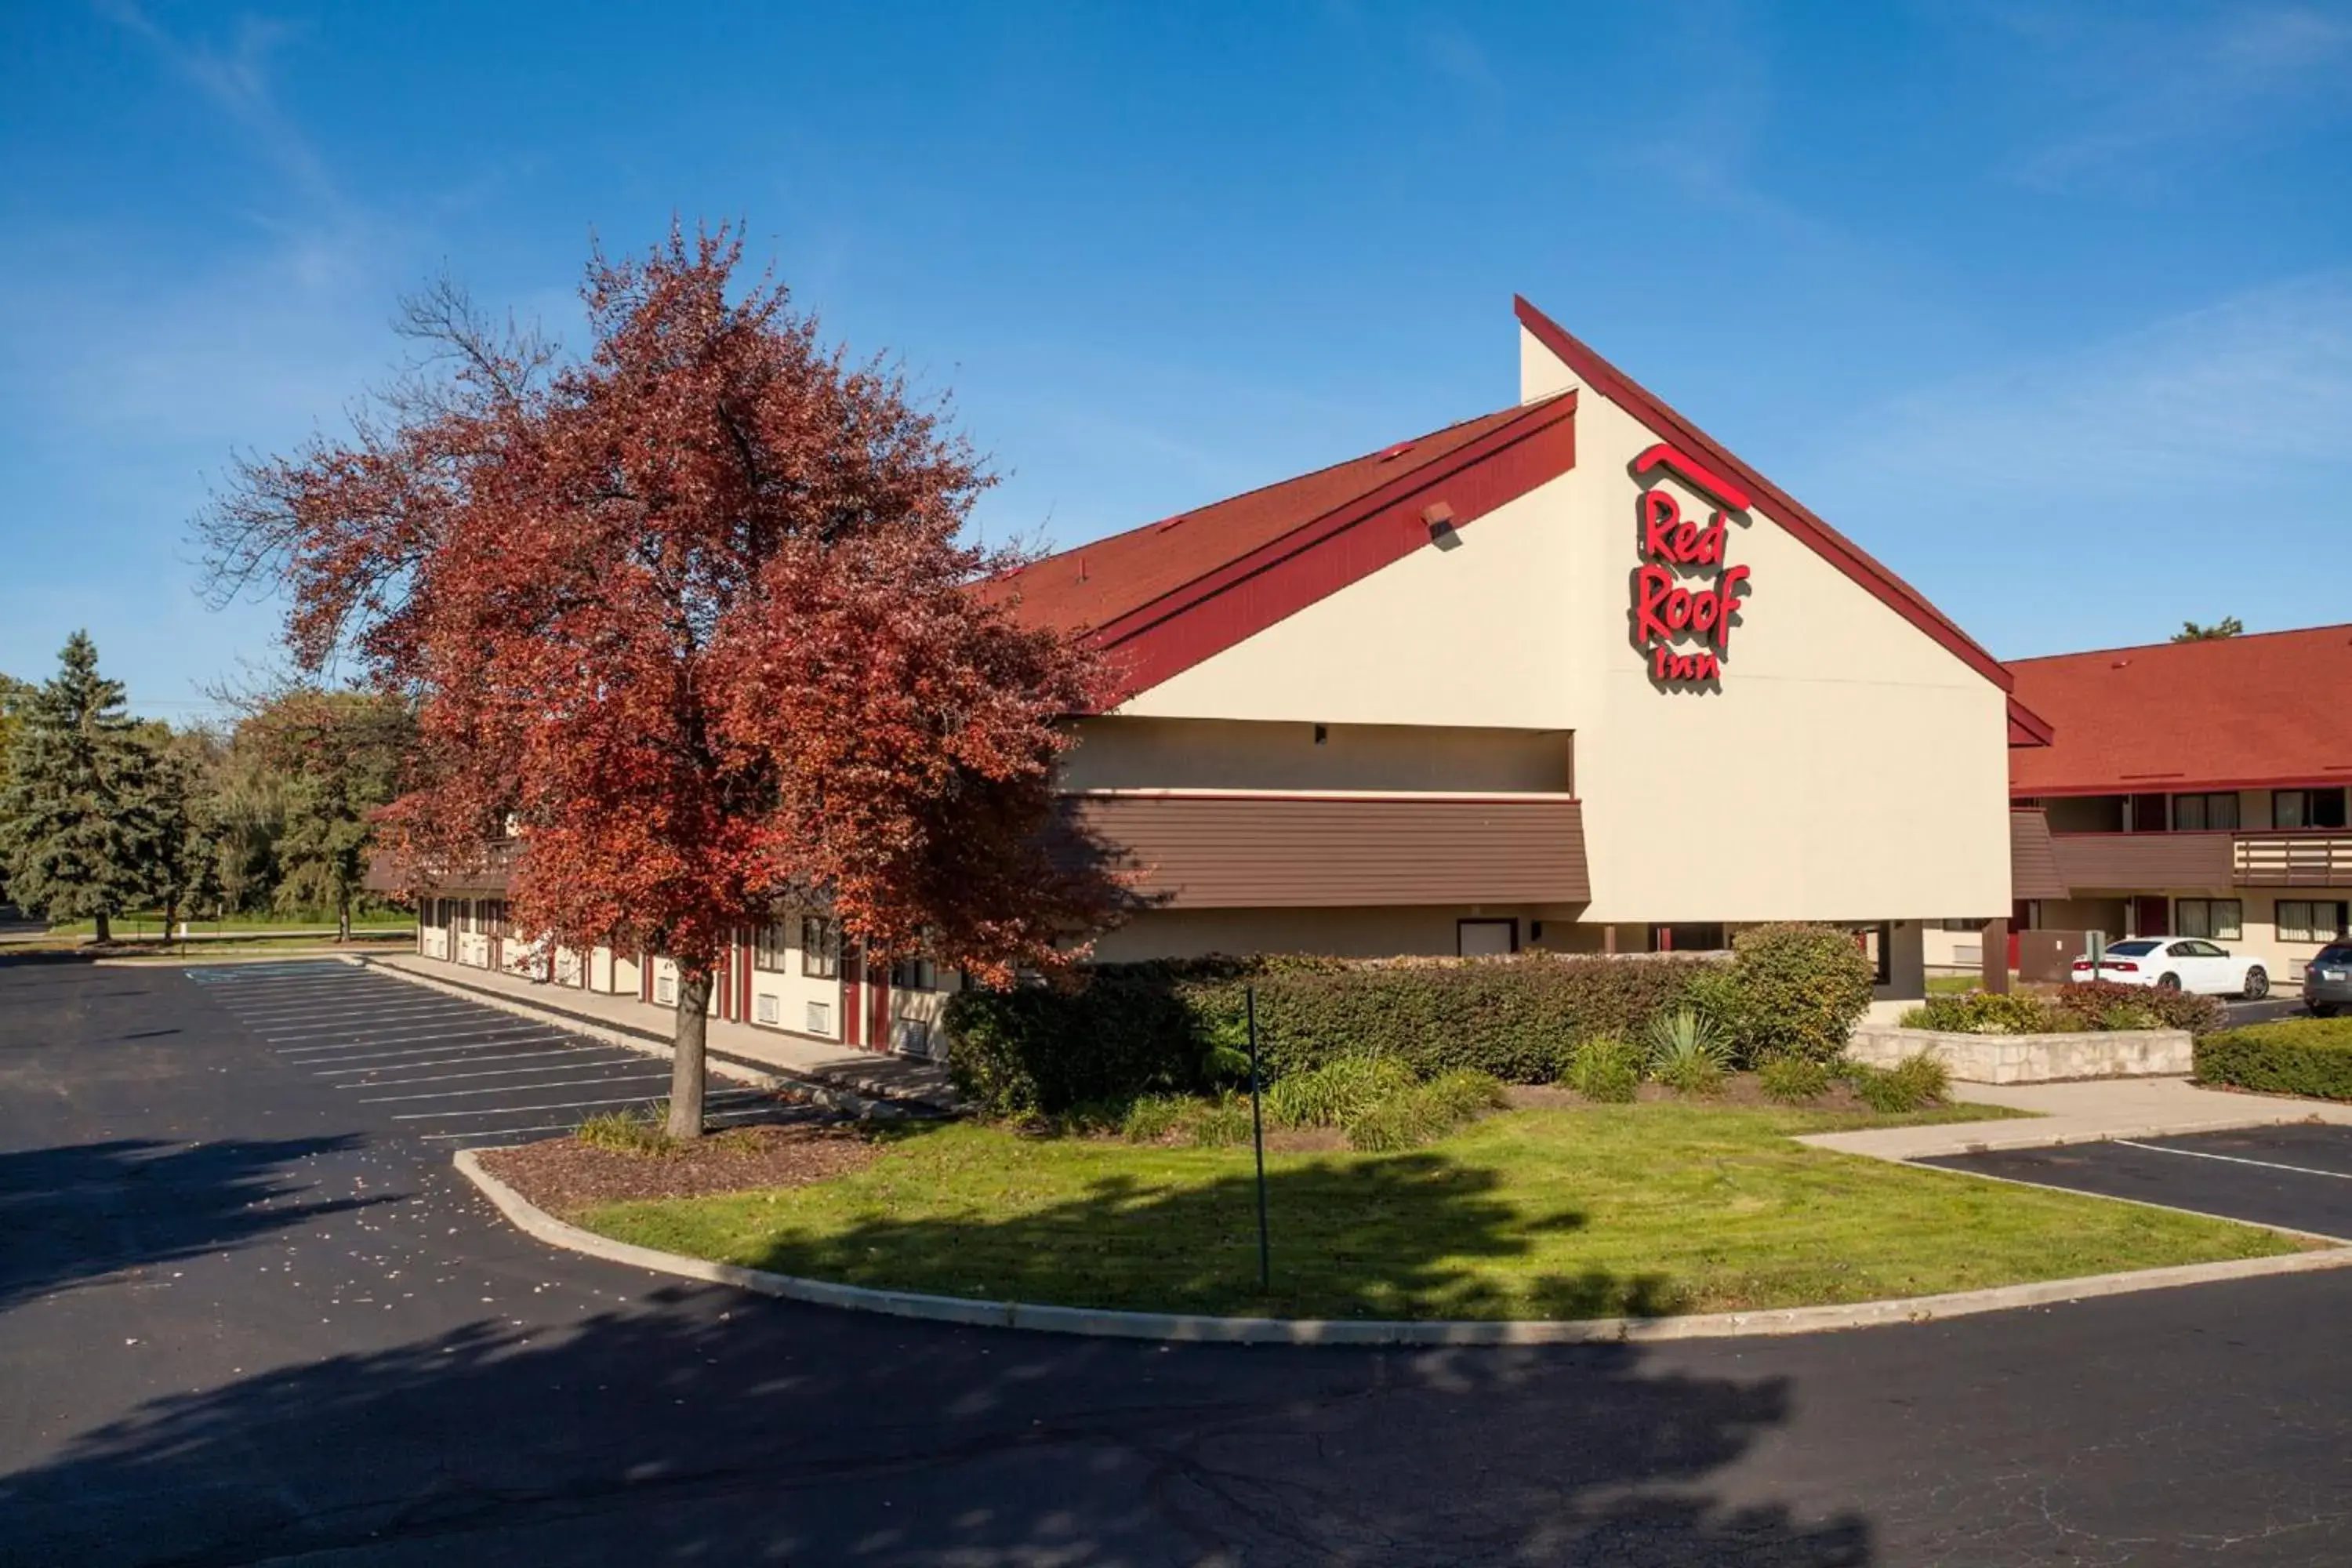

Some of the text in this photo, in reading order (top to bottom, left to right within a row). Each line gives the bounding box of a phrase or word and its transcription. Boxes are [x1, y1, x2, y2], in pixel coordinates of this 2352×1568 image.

[1646, 490, 1726, 564] Red
[1637, 564, 1750, 648] Roof
[1656, 647, 1720, 680] Inn
